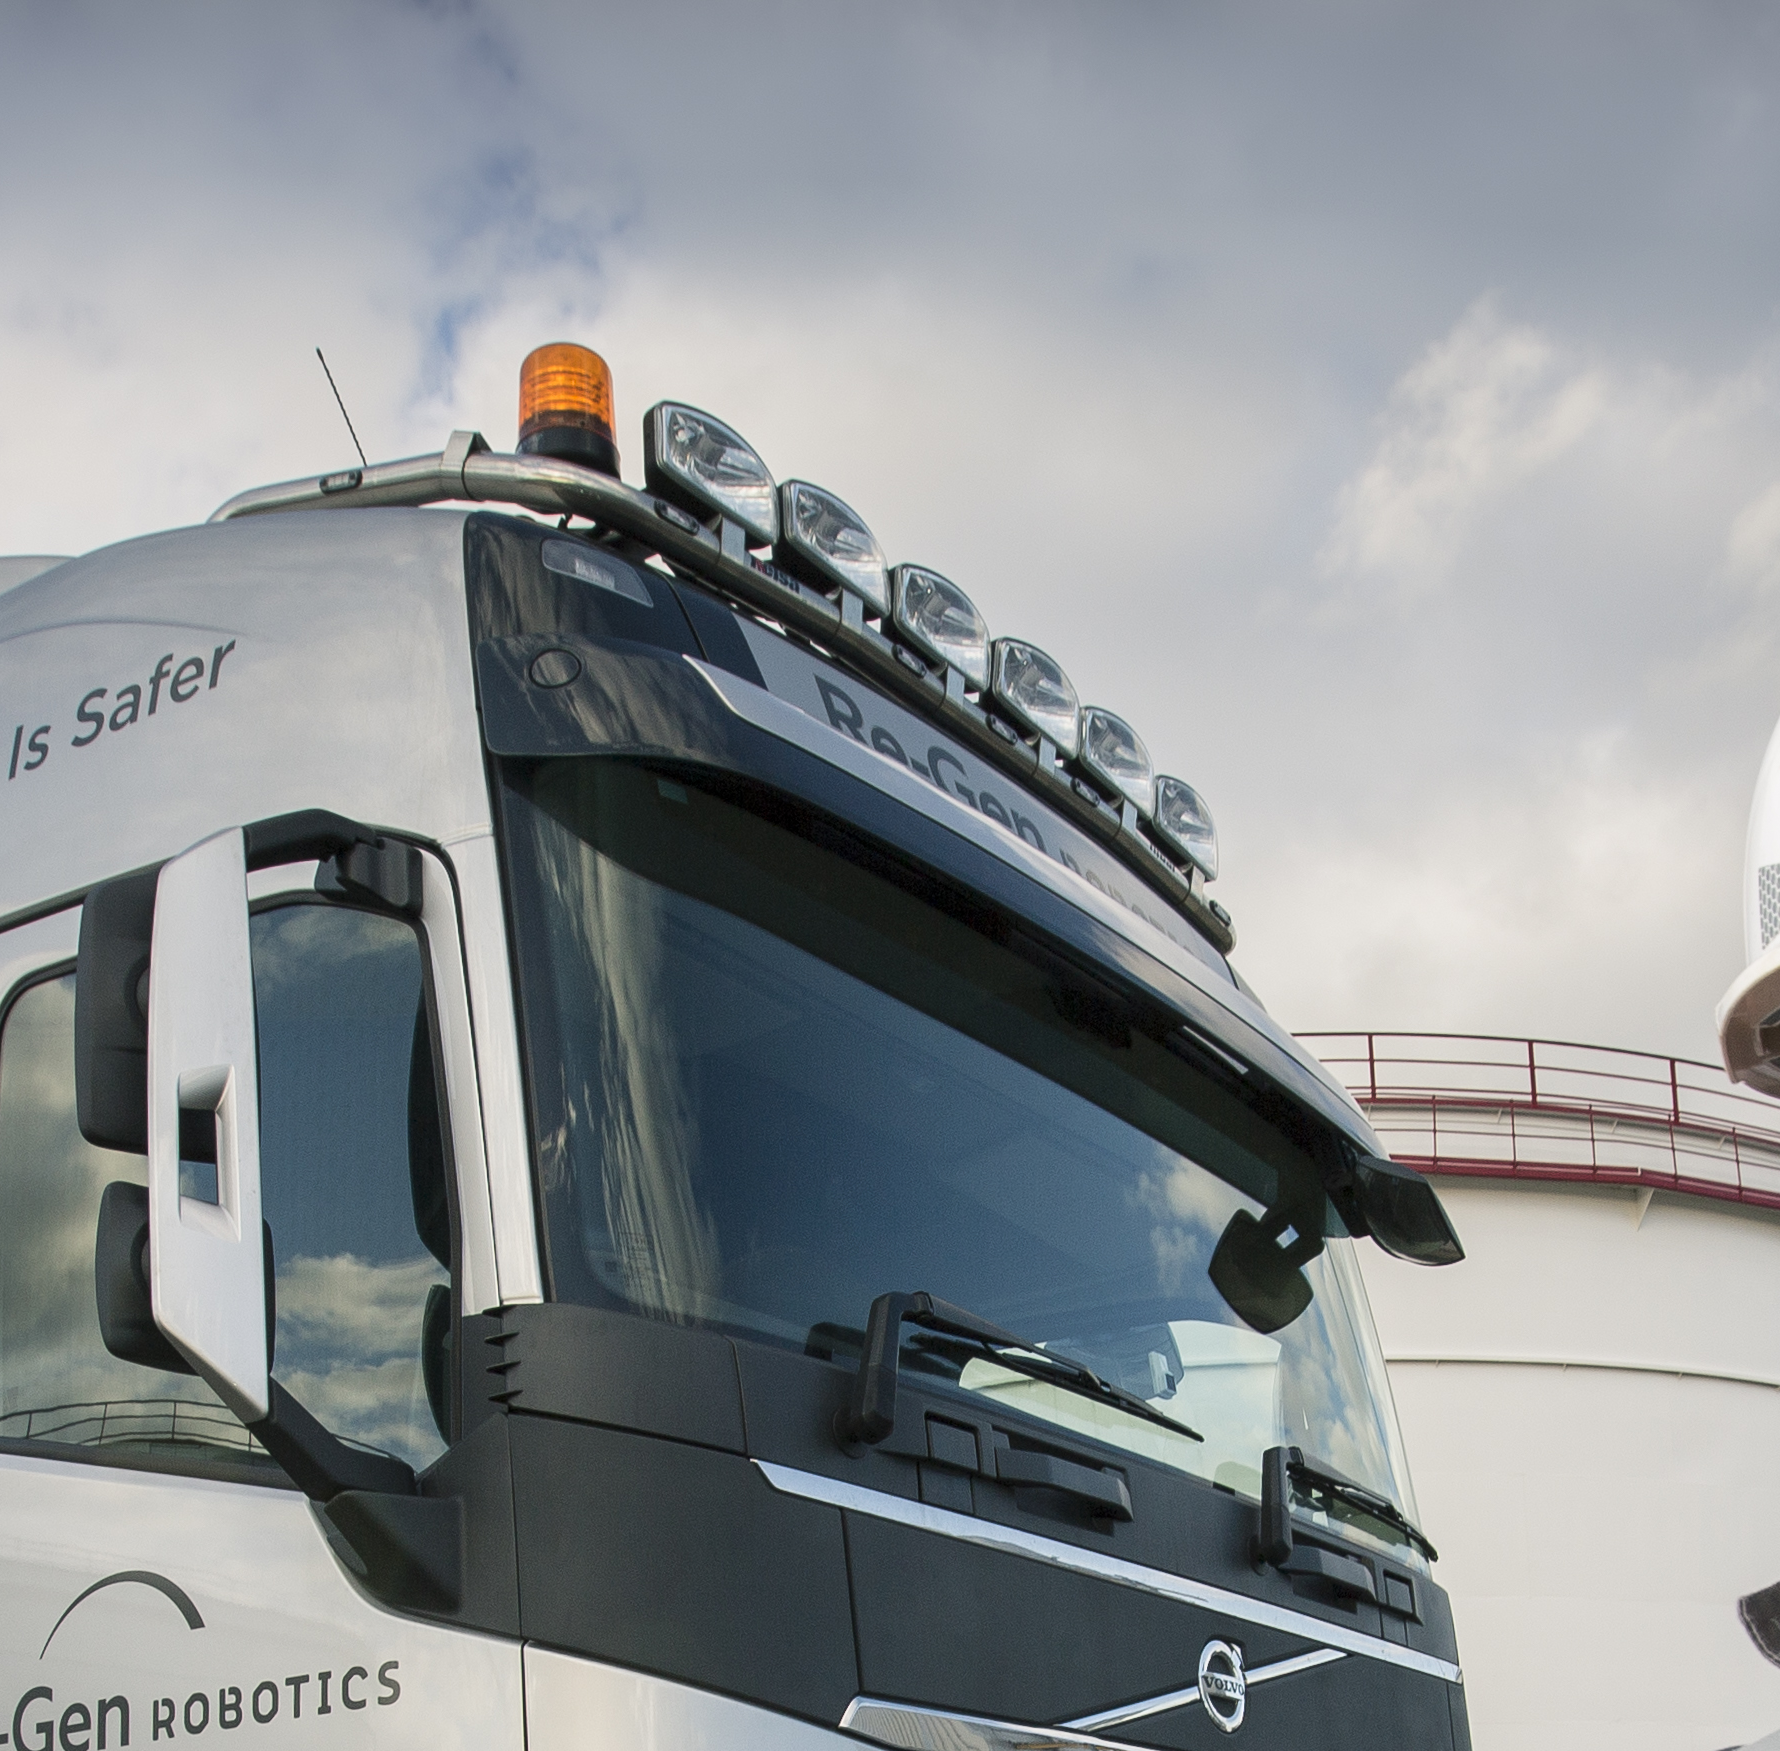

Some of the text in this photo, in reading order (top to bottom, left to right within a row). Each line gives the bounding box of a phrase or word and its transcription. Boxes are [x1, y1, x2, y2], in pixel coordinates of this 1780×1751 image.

[8, 725, 52, 781] Is
[71, 639, 236, 748] Safer
[151, 1660, 401, 1742] ROBOTICS
[1201, 1675, 1245, 1696] VOLVO
